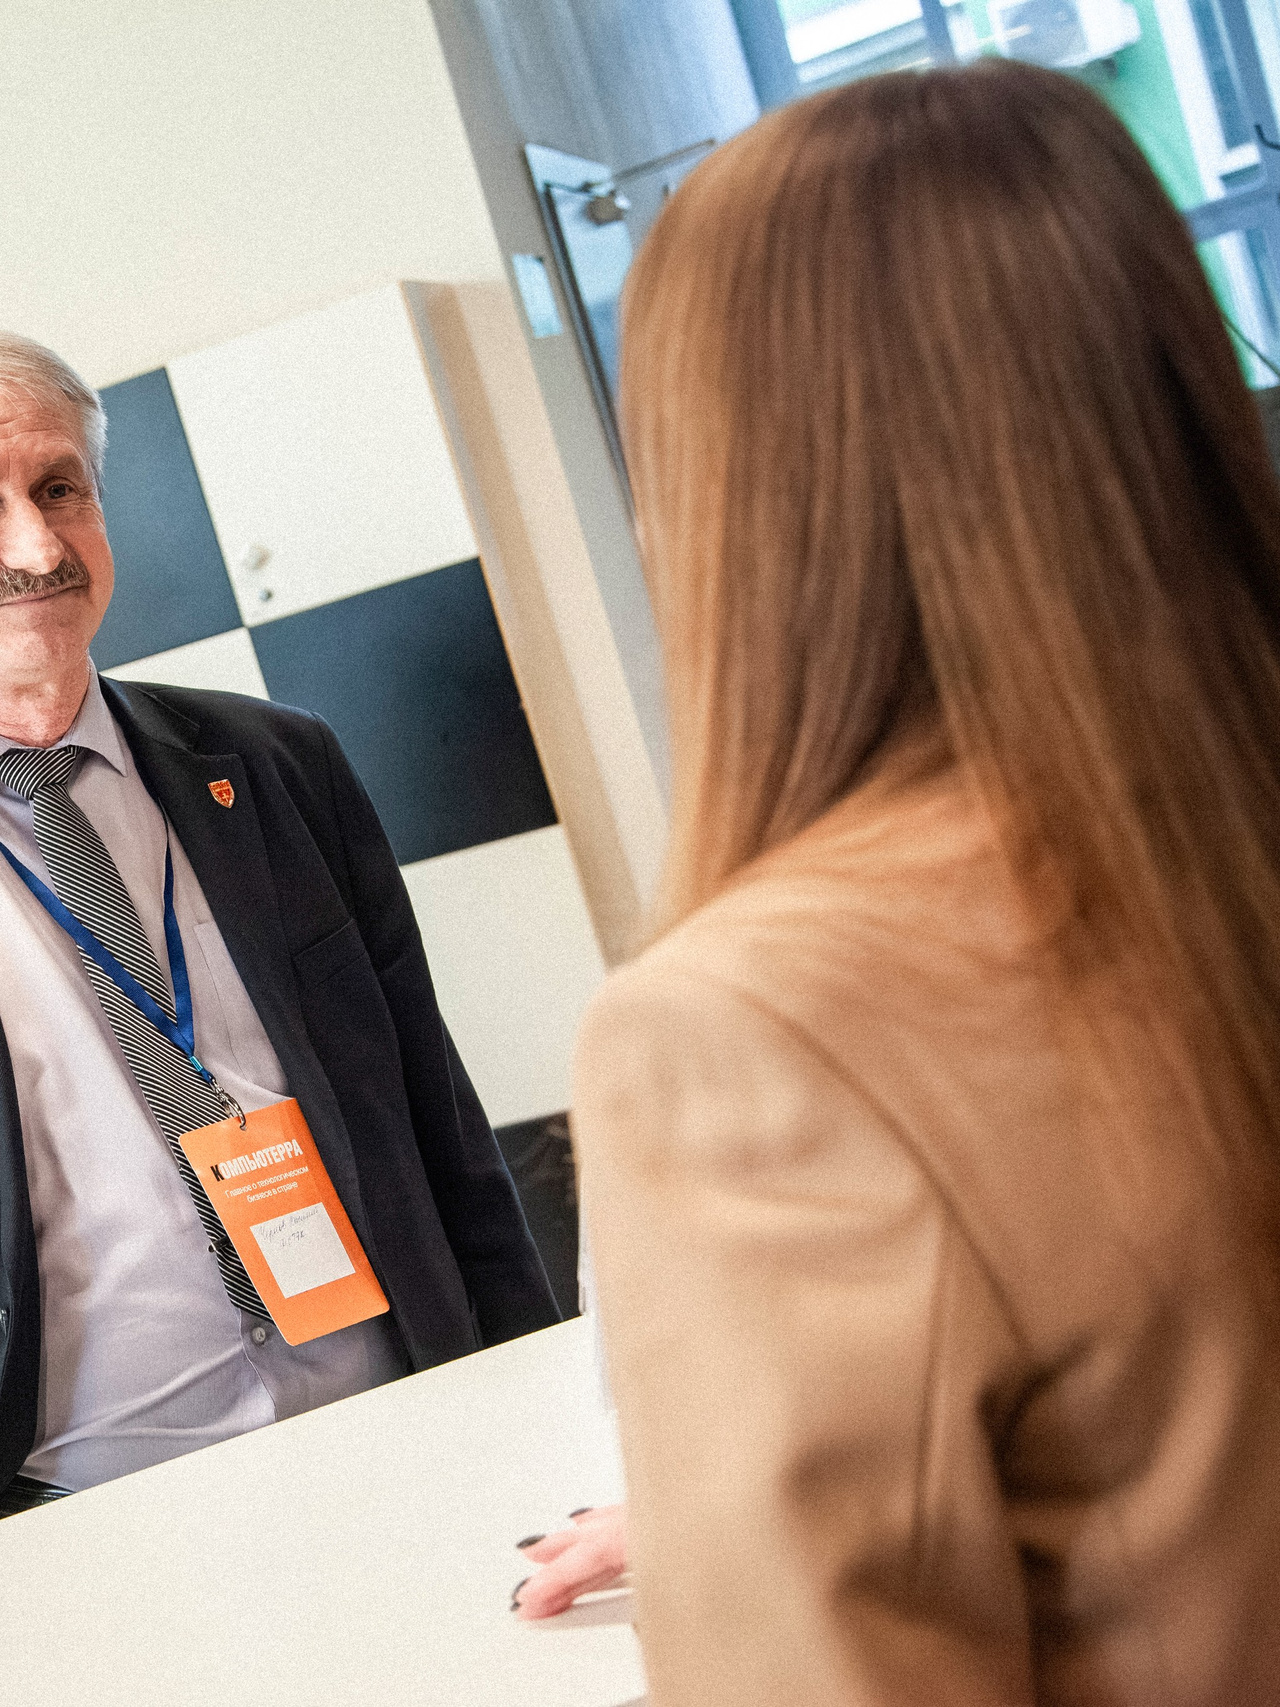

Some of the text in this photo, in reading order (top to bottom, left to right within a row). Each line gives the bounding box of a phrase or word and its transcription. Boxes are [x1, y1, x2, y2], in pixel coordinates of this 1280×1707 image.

[210, 1139, 304, 1182] КОМПЬЮТЕРРА
[224, 1184, 252, 1198] Главное
[257, 1166, 309, 1188] технологическом
[247, 1190, 273, 1203] бизнесе
[278, 1181, 298, 1193] стране
